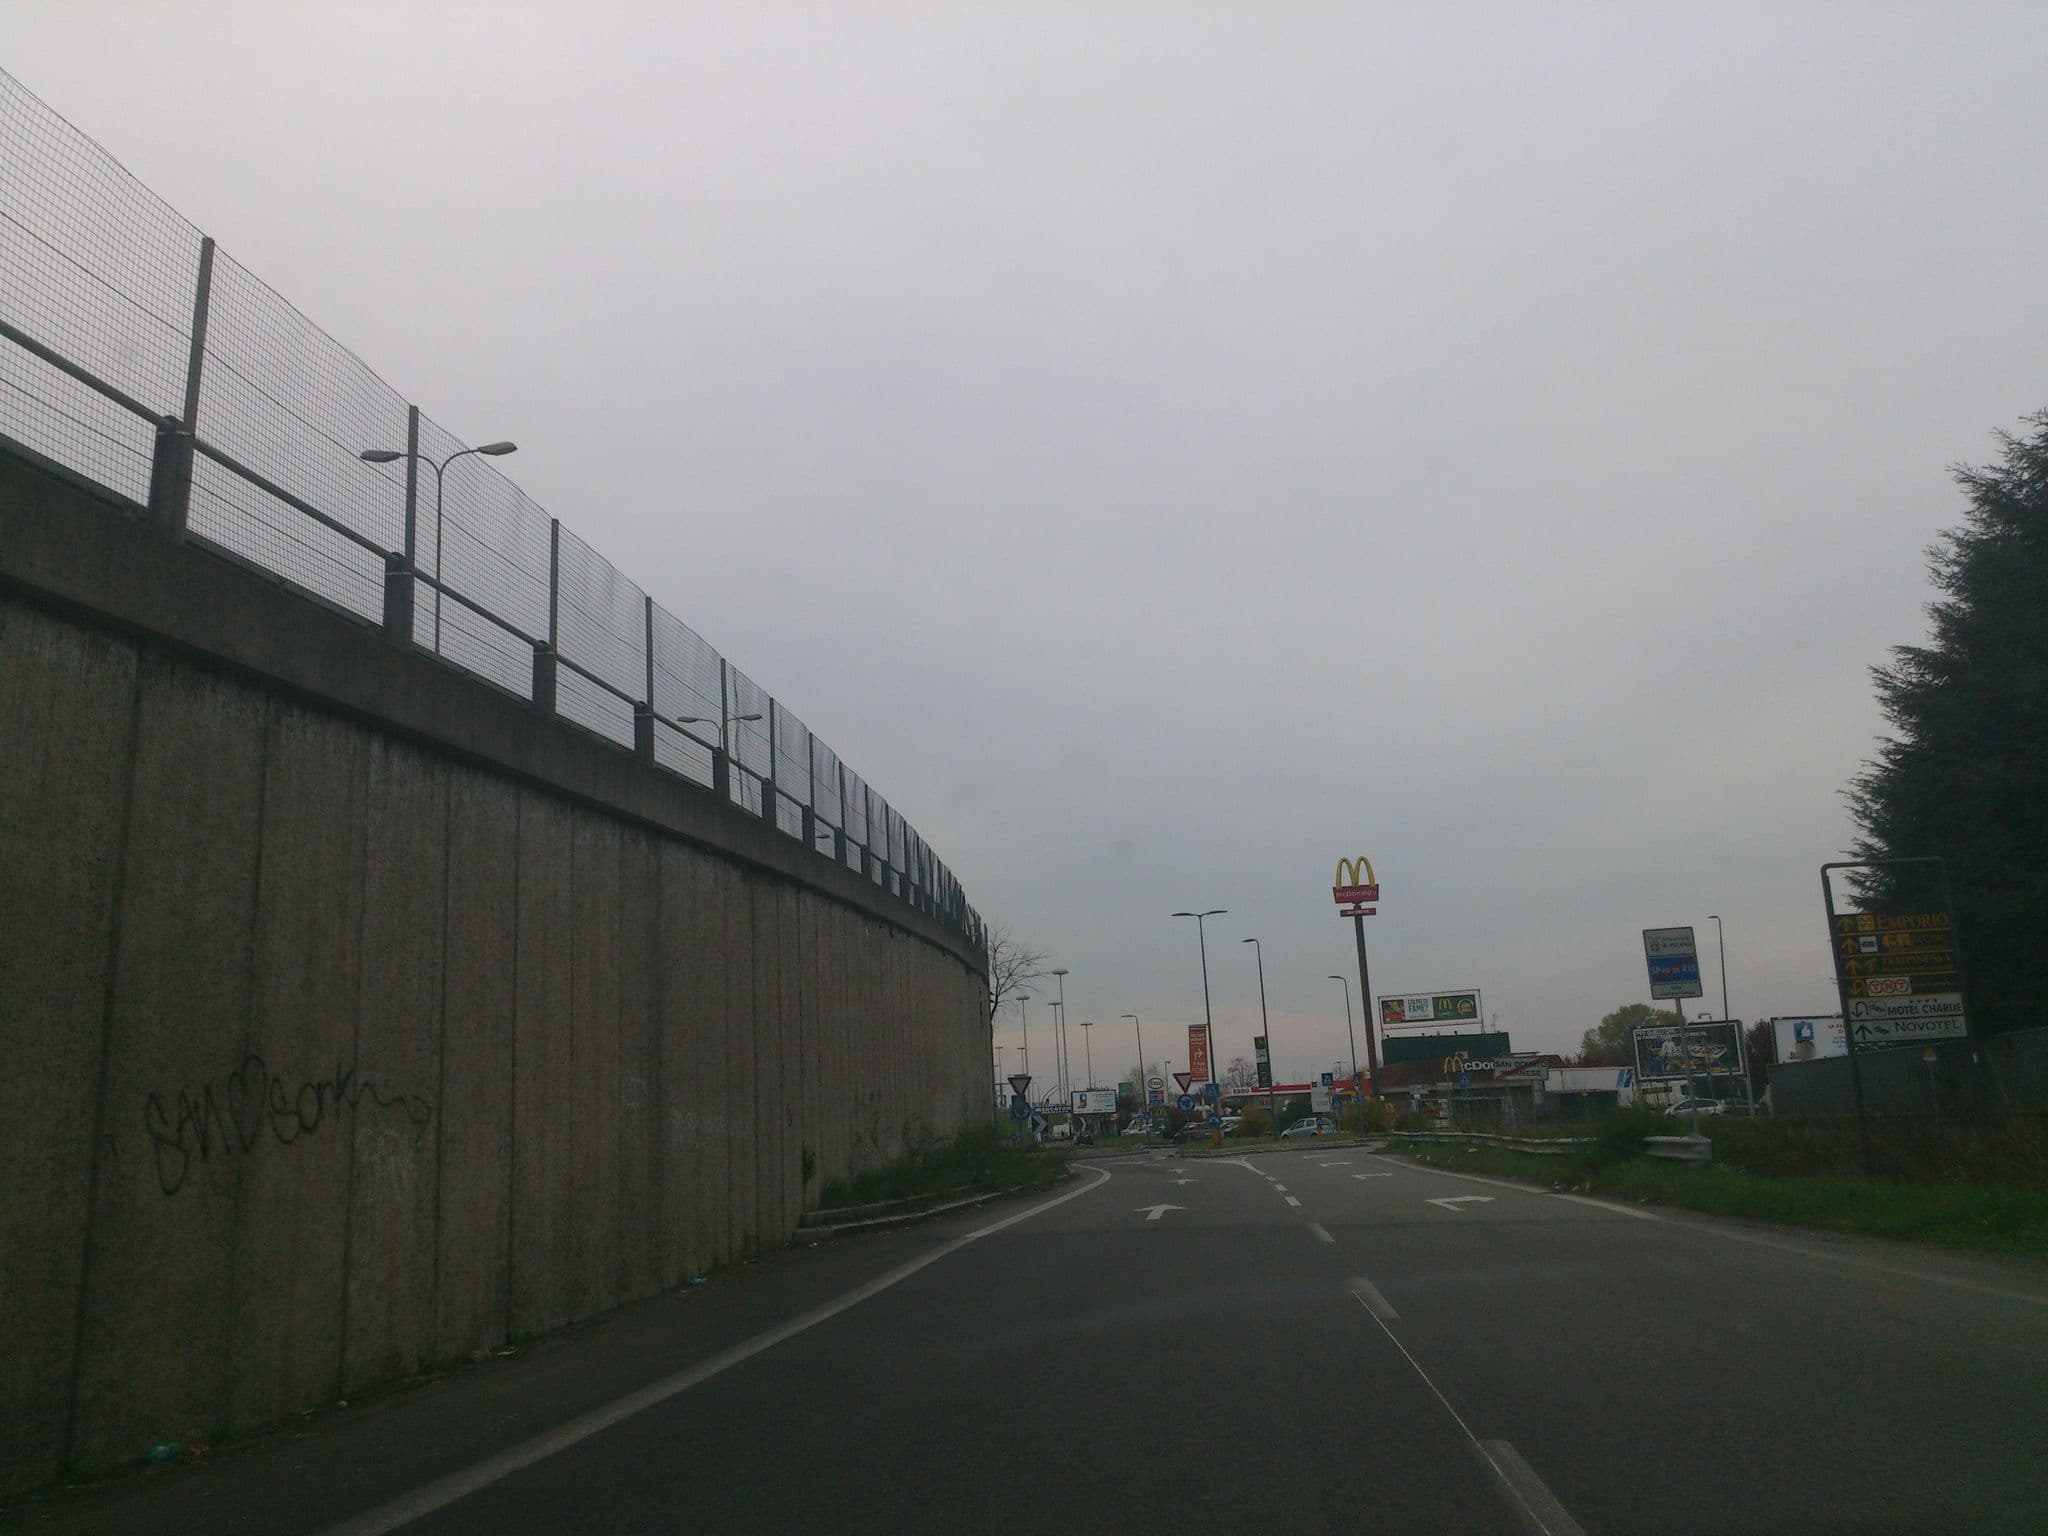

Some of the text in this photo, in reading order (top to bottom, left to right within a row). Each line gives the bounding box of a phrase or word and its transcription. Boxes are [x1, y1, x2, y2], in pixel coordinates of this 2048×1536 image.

[1887, 1002, 1962, 1016] MOTEL CHARLIE
[1894, 1019, 1960, 1032] NOVOTEL
